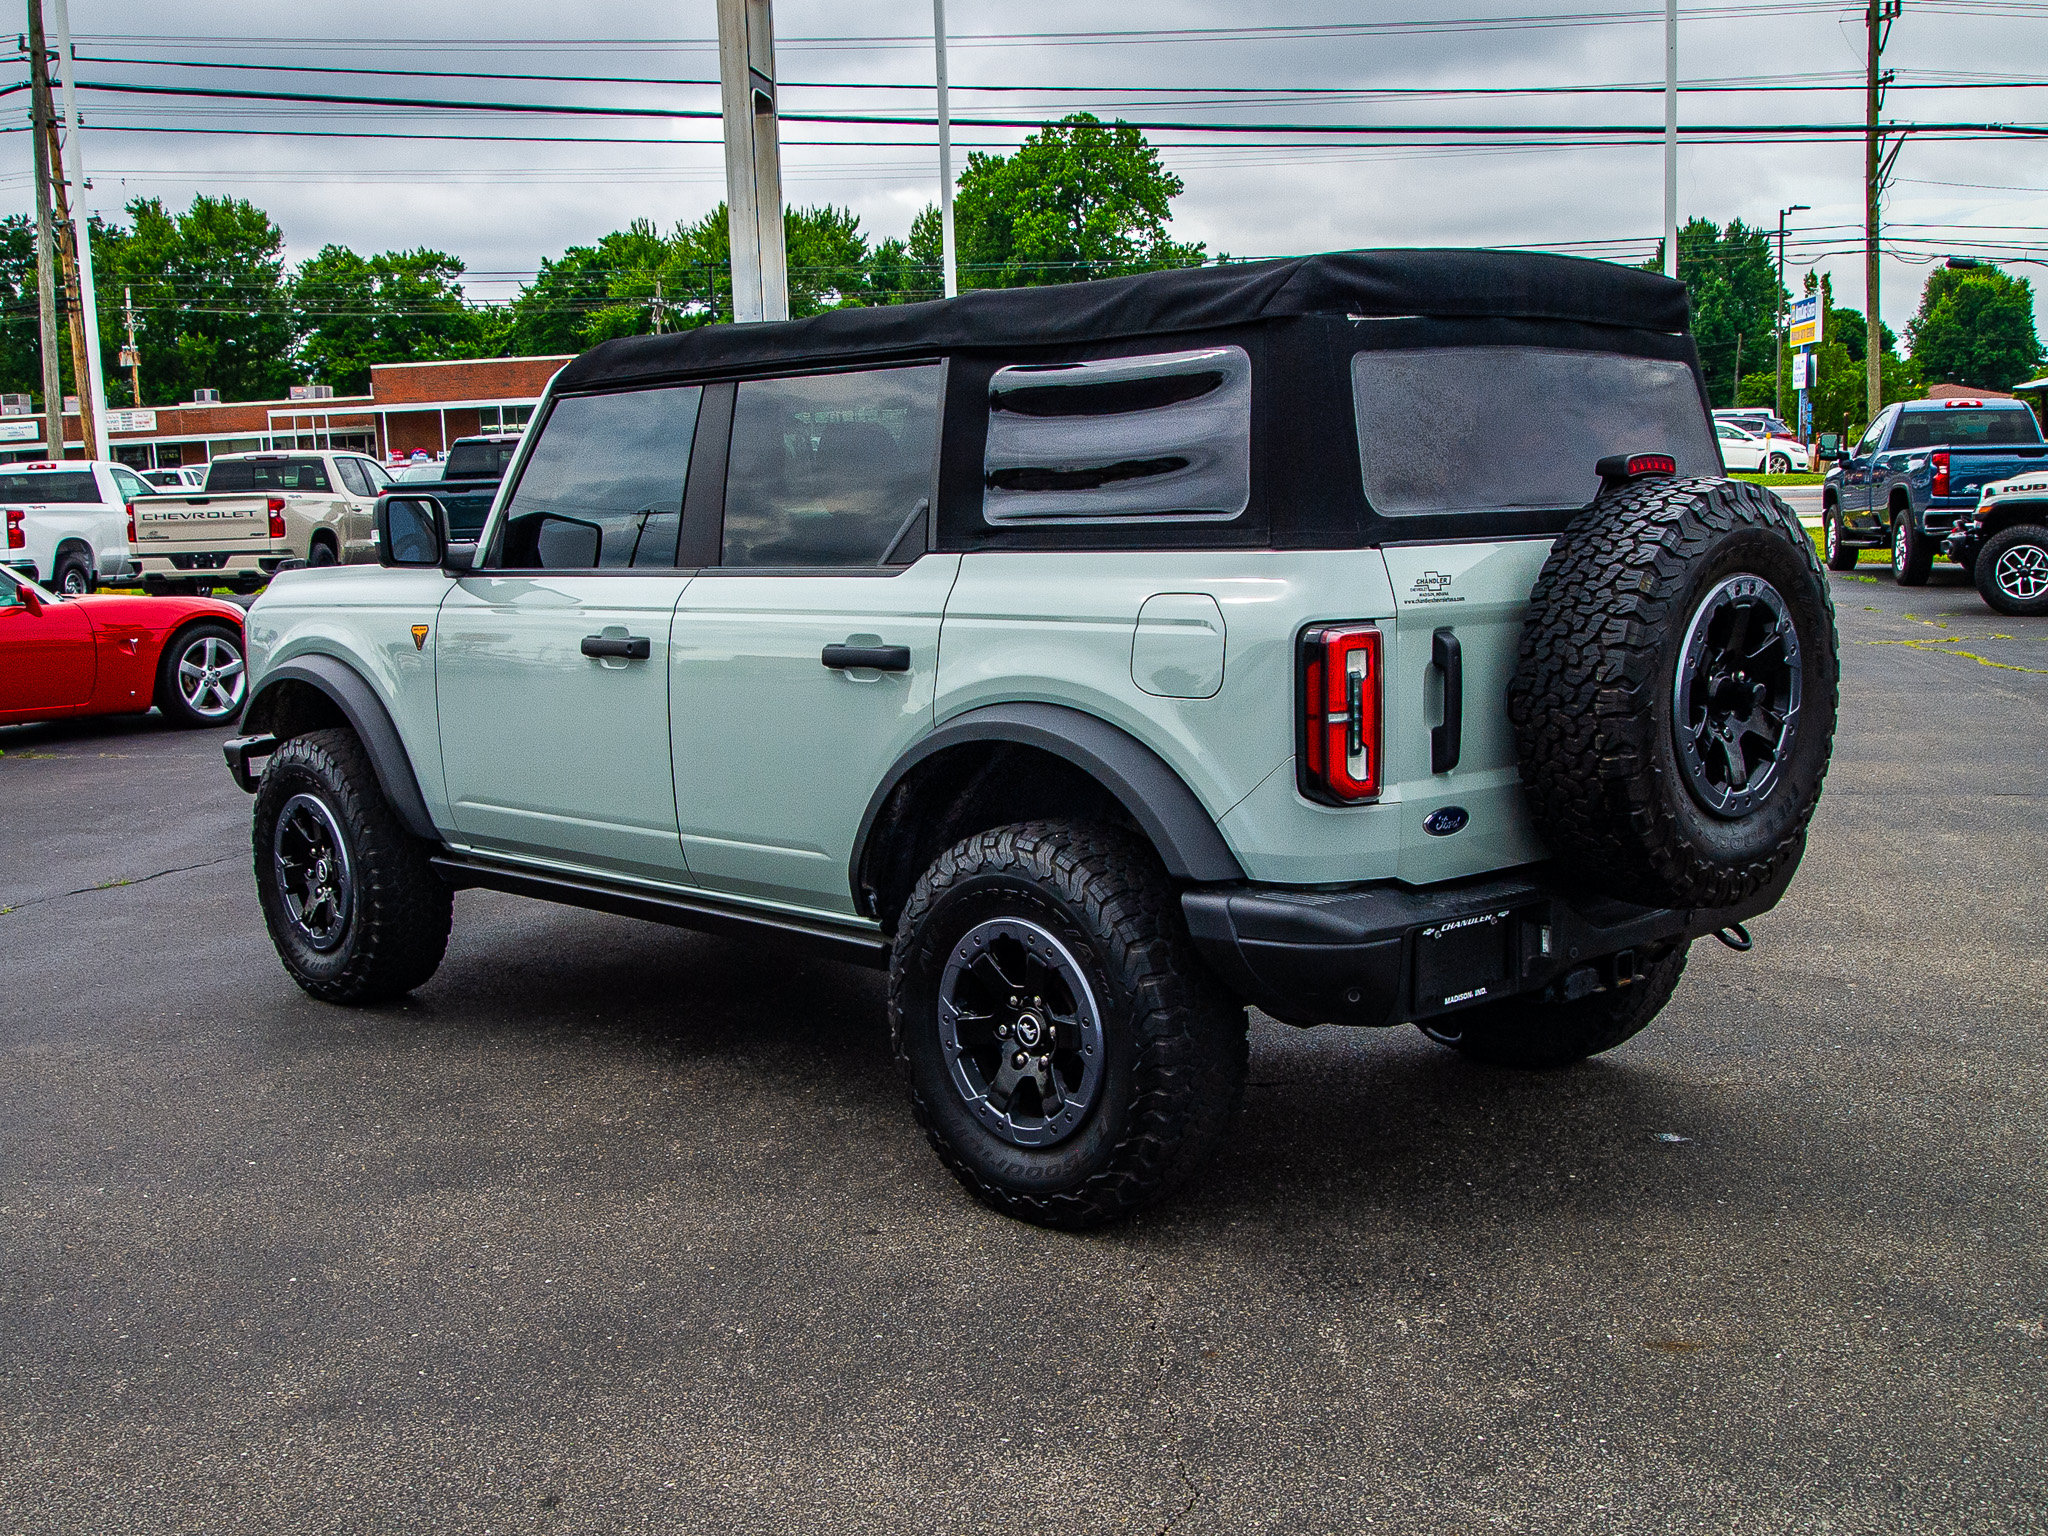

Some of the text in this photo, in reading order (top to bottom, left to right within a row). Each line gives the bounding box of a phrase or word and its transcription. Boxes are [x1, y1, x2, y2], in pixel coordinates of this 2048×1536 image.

[142, 510, 257, 521] CHEVROLET
[1415, 577, 1448, 585] CHANDLER
[1435, 815, 1461, 831] Ford
[1441, 914, 1493, 932] CHANDLER
